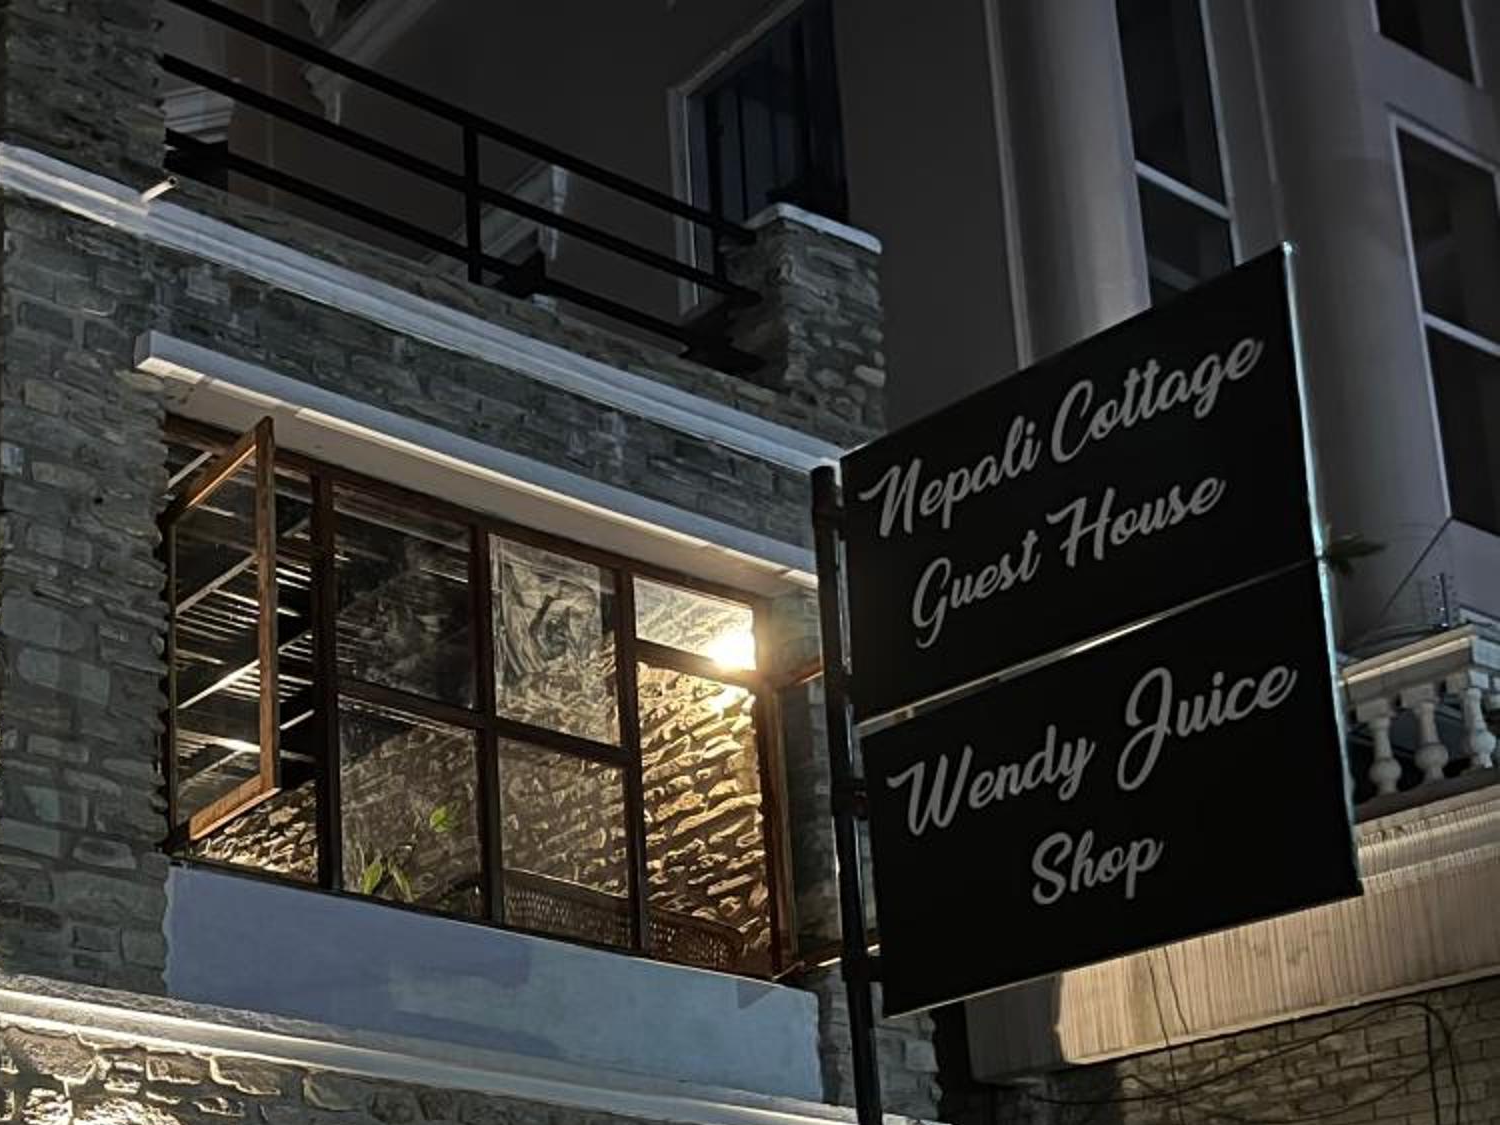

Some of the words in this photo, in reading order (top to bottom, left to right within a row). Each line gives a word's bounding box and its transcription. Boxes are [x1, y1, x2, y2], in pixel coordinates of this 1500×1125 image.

[858, 415, 1042, 538] Nepali
[1051, 337, 1264, 464] Cottage
[912, 537, 1042, 649] Guest
[1046, 477, 1227, 568] House
[887, 724, 1097, 837] Wendy
[1117, 666, 1298, 791] Juice
[1032, 830, 1164, 905] Shop
